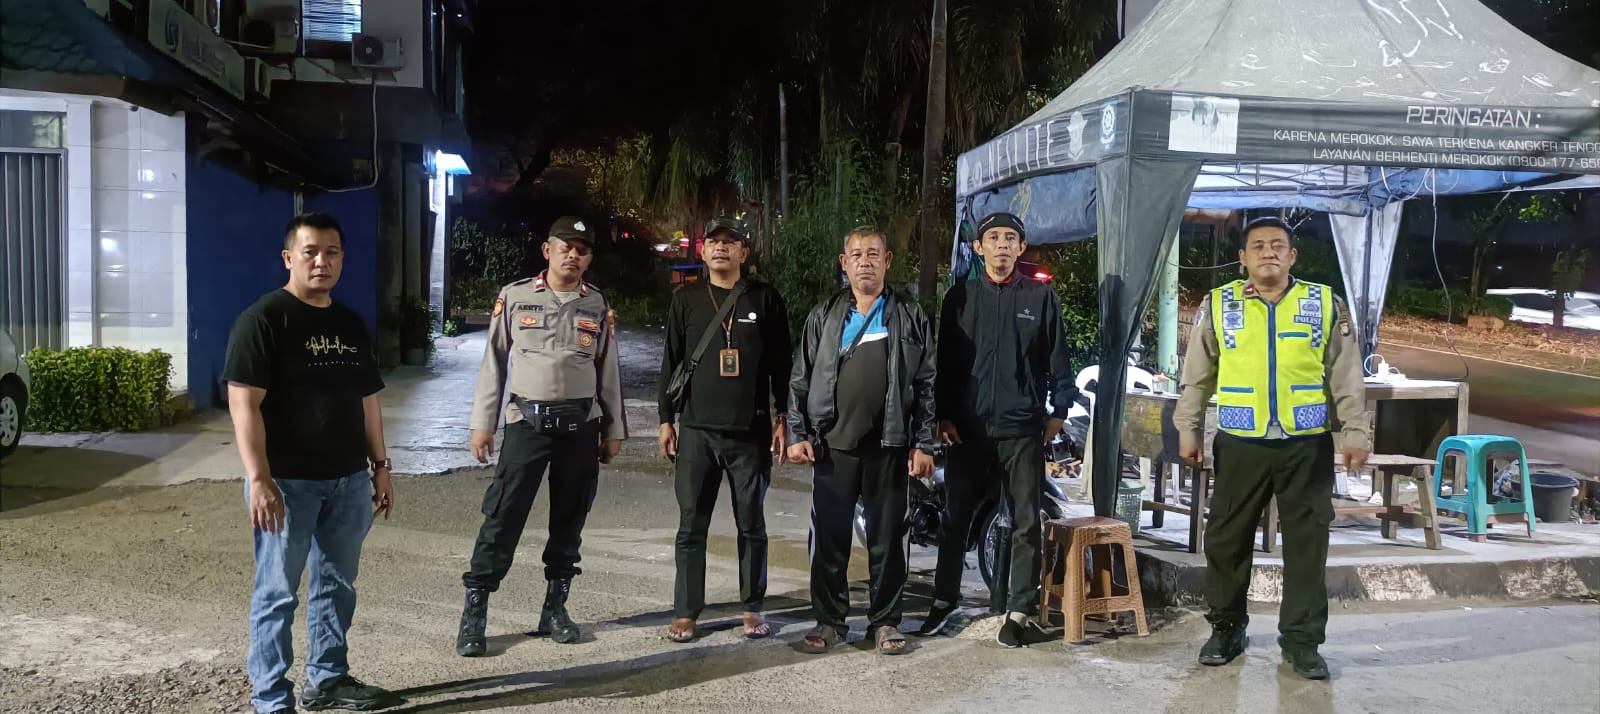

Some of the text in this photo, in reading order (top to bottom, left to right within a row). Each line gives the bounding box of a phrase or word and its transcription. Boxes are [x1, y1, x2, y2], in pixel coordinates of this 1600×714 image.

[1406, 105, 1531, 128] PERINGATAN
[1273, 129, 1327, 143] KARENA
[1402, 135, 1434, 148] SAYA
[1438, 137, 1495, 150] TERKENA
[1499, 139, 1558, 152] KANGKER
[1313, 148, 1371, 161] LAYANAN
[1375, 151, 1438, 165] BERHENTI
[1442, 153, 1505, 166] MEROKOK
